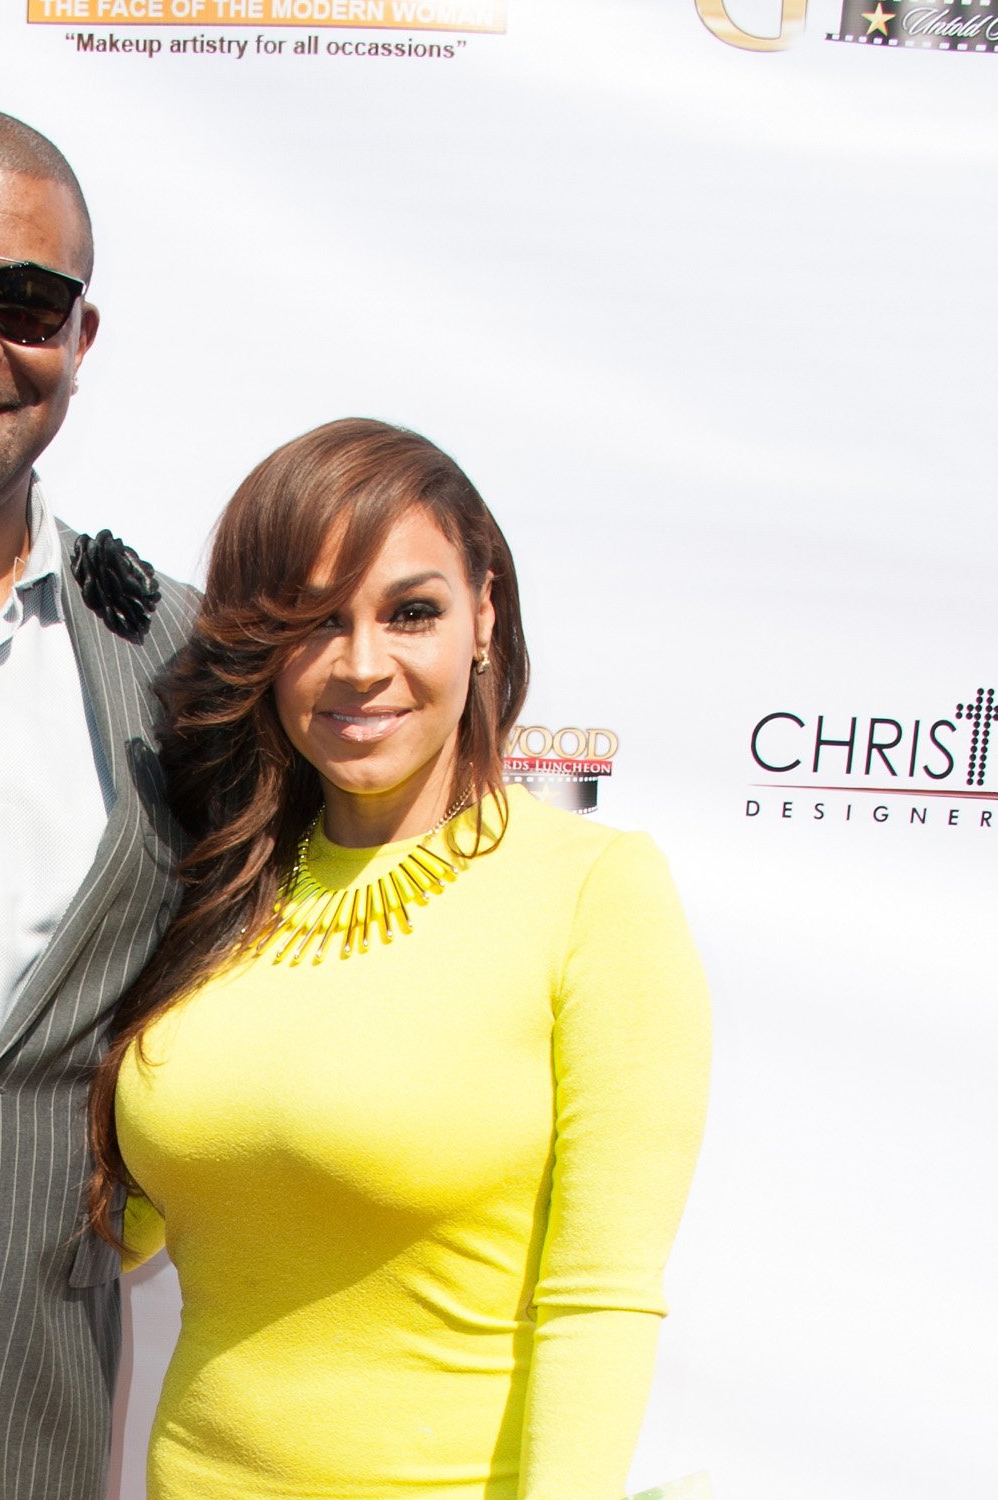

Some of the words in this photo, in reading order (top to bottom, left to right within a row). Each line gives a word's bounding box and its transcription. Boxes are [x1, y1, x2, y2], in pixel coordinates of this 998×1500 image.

[96, 0, 163, 18] FACE
[170, 0, 206, 18] OF
[211, 0, 264, 18] THE
[271, 0, 384, 21] MODERN
[391, 0, 496, 25] WOMAN
[902, 7, 994, 38] Untold
[170, 34, 248, 59] artistry
[255, 35, 286, 55] for
[293, 35, 319, 55] all
[535, 759, 612, 774] LUNCHEON
[745, 800, 993, 828] DESIGNER
